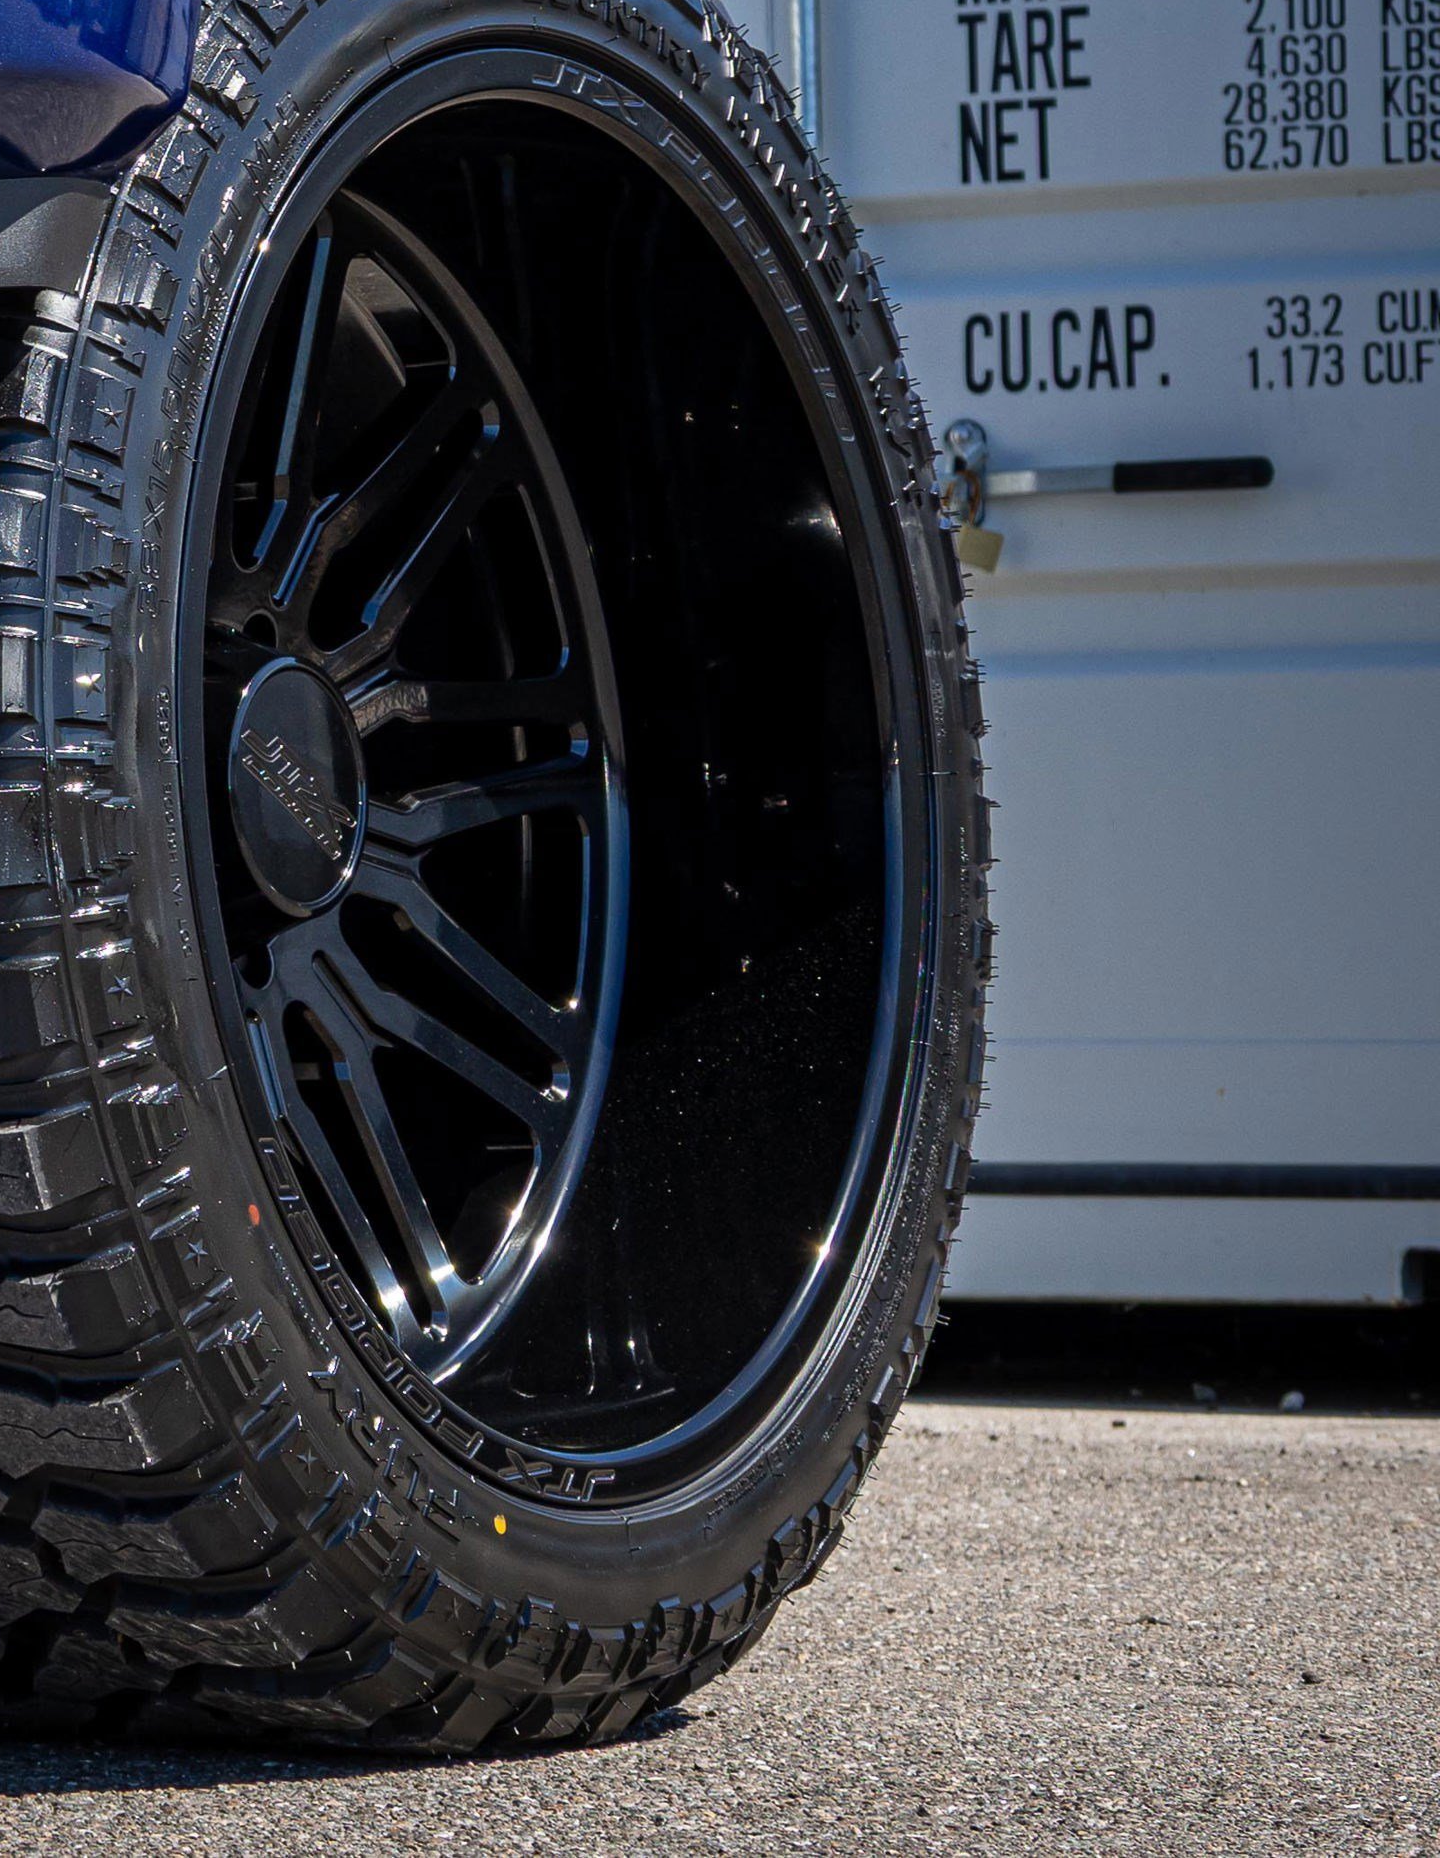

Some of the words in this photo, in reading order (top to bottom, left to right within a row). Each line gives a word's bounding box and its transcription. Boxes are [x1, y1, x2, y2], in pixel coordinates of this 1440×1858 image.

[958, 6, 1090, 94] TARE
[1247, 31, 1347, 78] 4.630
[530, 53, 646, 128] JTX
[960, 98, 1057, 184] NET
[1223, 77, 1348, 126] 28.380
[1224, 124, 1349, 171] 62.570
[964, 304, 1169, 394] CU.CAP.
[1265, 294, 1342, 338] 33.2
[1248, 344, 1344, 390] 1.173
[1364, 339, 1440, 385] CU.F
[258, 1136, 484, 1462] FORGED
[497, 1446, 617, 1505] JTX
